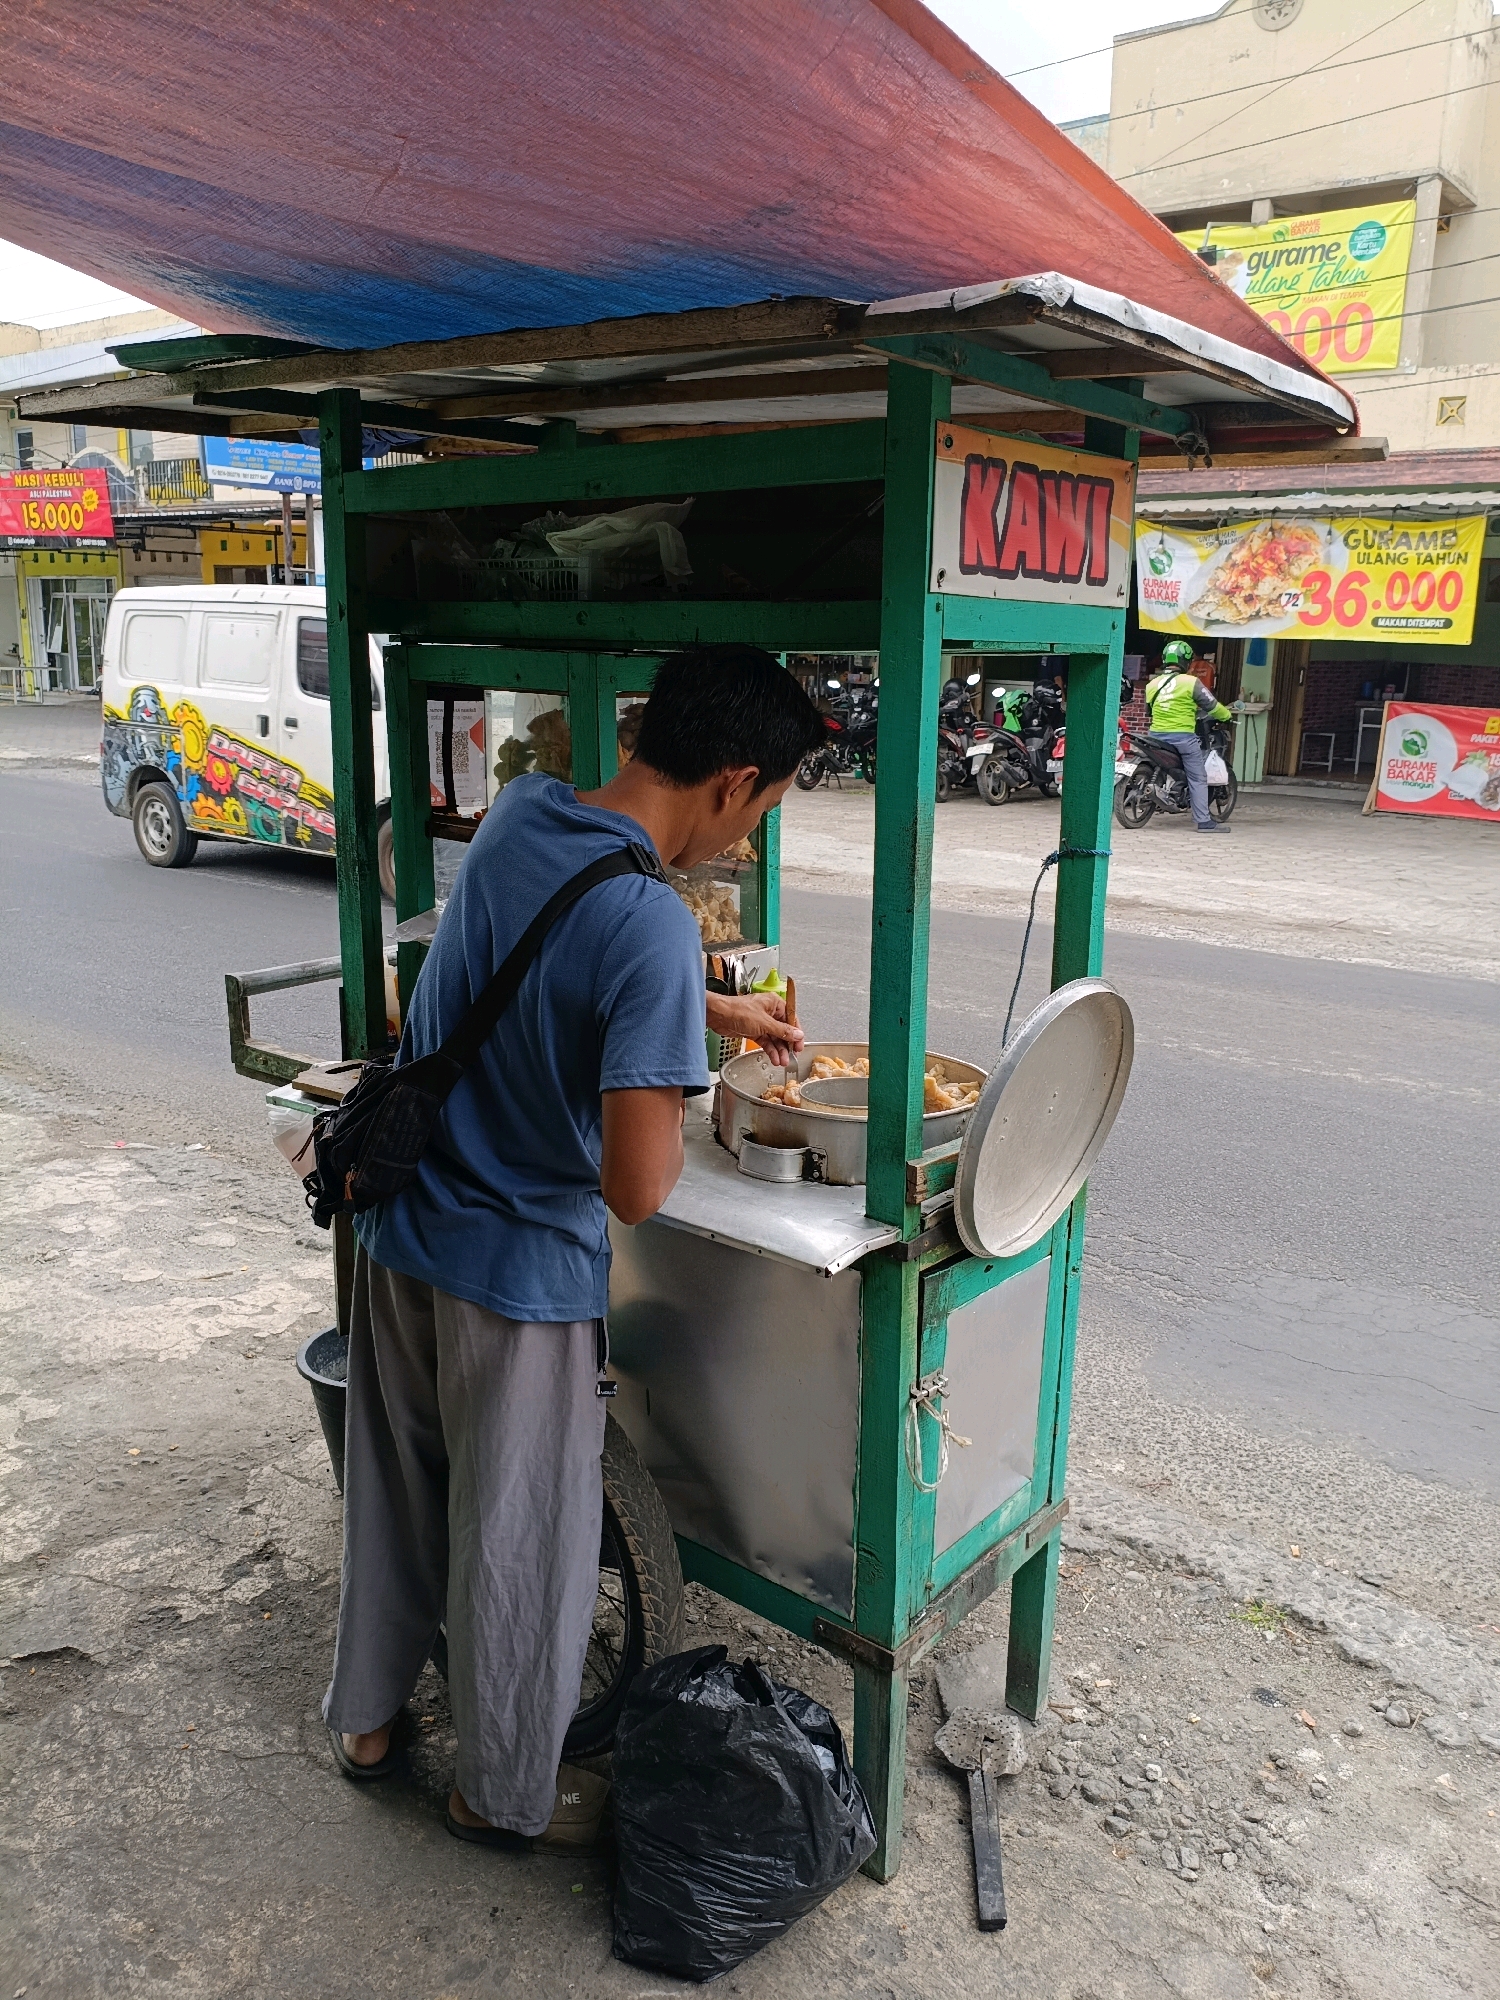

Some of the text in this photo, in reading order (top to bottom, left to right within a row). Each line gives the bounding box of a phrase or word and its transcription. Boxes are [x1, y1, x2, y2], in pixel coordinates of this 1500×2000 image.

[1290, 219, 1321, 229] GURAME
[1290, 227, 1321, 236] BAKAR
[1246, 242, 1341, 276] gurame
[1245, 263, 1303, 310] ulang
[1302, 295, 1329, 304] MAKAN
[1339, 291, 1369, 300] TEMPAT
[15, 473, 40, 488] NASI
[274, 478, 294, 486] BANK
[22, 501, 84, 532] 15,000
[961, 456, 1113, 584] KAWI
[1343, 528, 1458, 550] GURAME
[1357, 551, 1469, 566] ULANG TAHUN
[1142, 578, 1181, 591] GURAME
[1143, 587, 1180, 602] BAKAR
[1298, 569, 1464, 629] 36.000
[1377, 617, 1445, 628] MAKAN DITEMPAT
[207, 729, 303, 793] DAFFA
[1387, 759, 1437, 772] GURAME
[1387, 769, 1436, 783] BAKAR
[1402, 781, 1434, 790] mangun
[561, 1792, 581, 1806] NE
